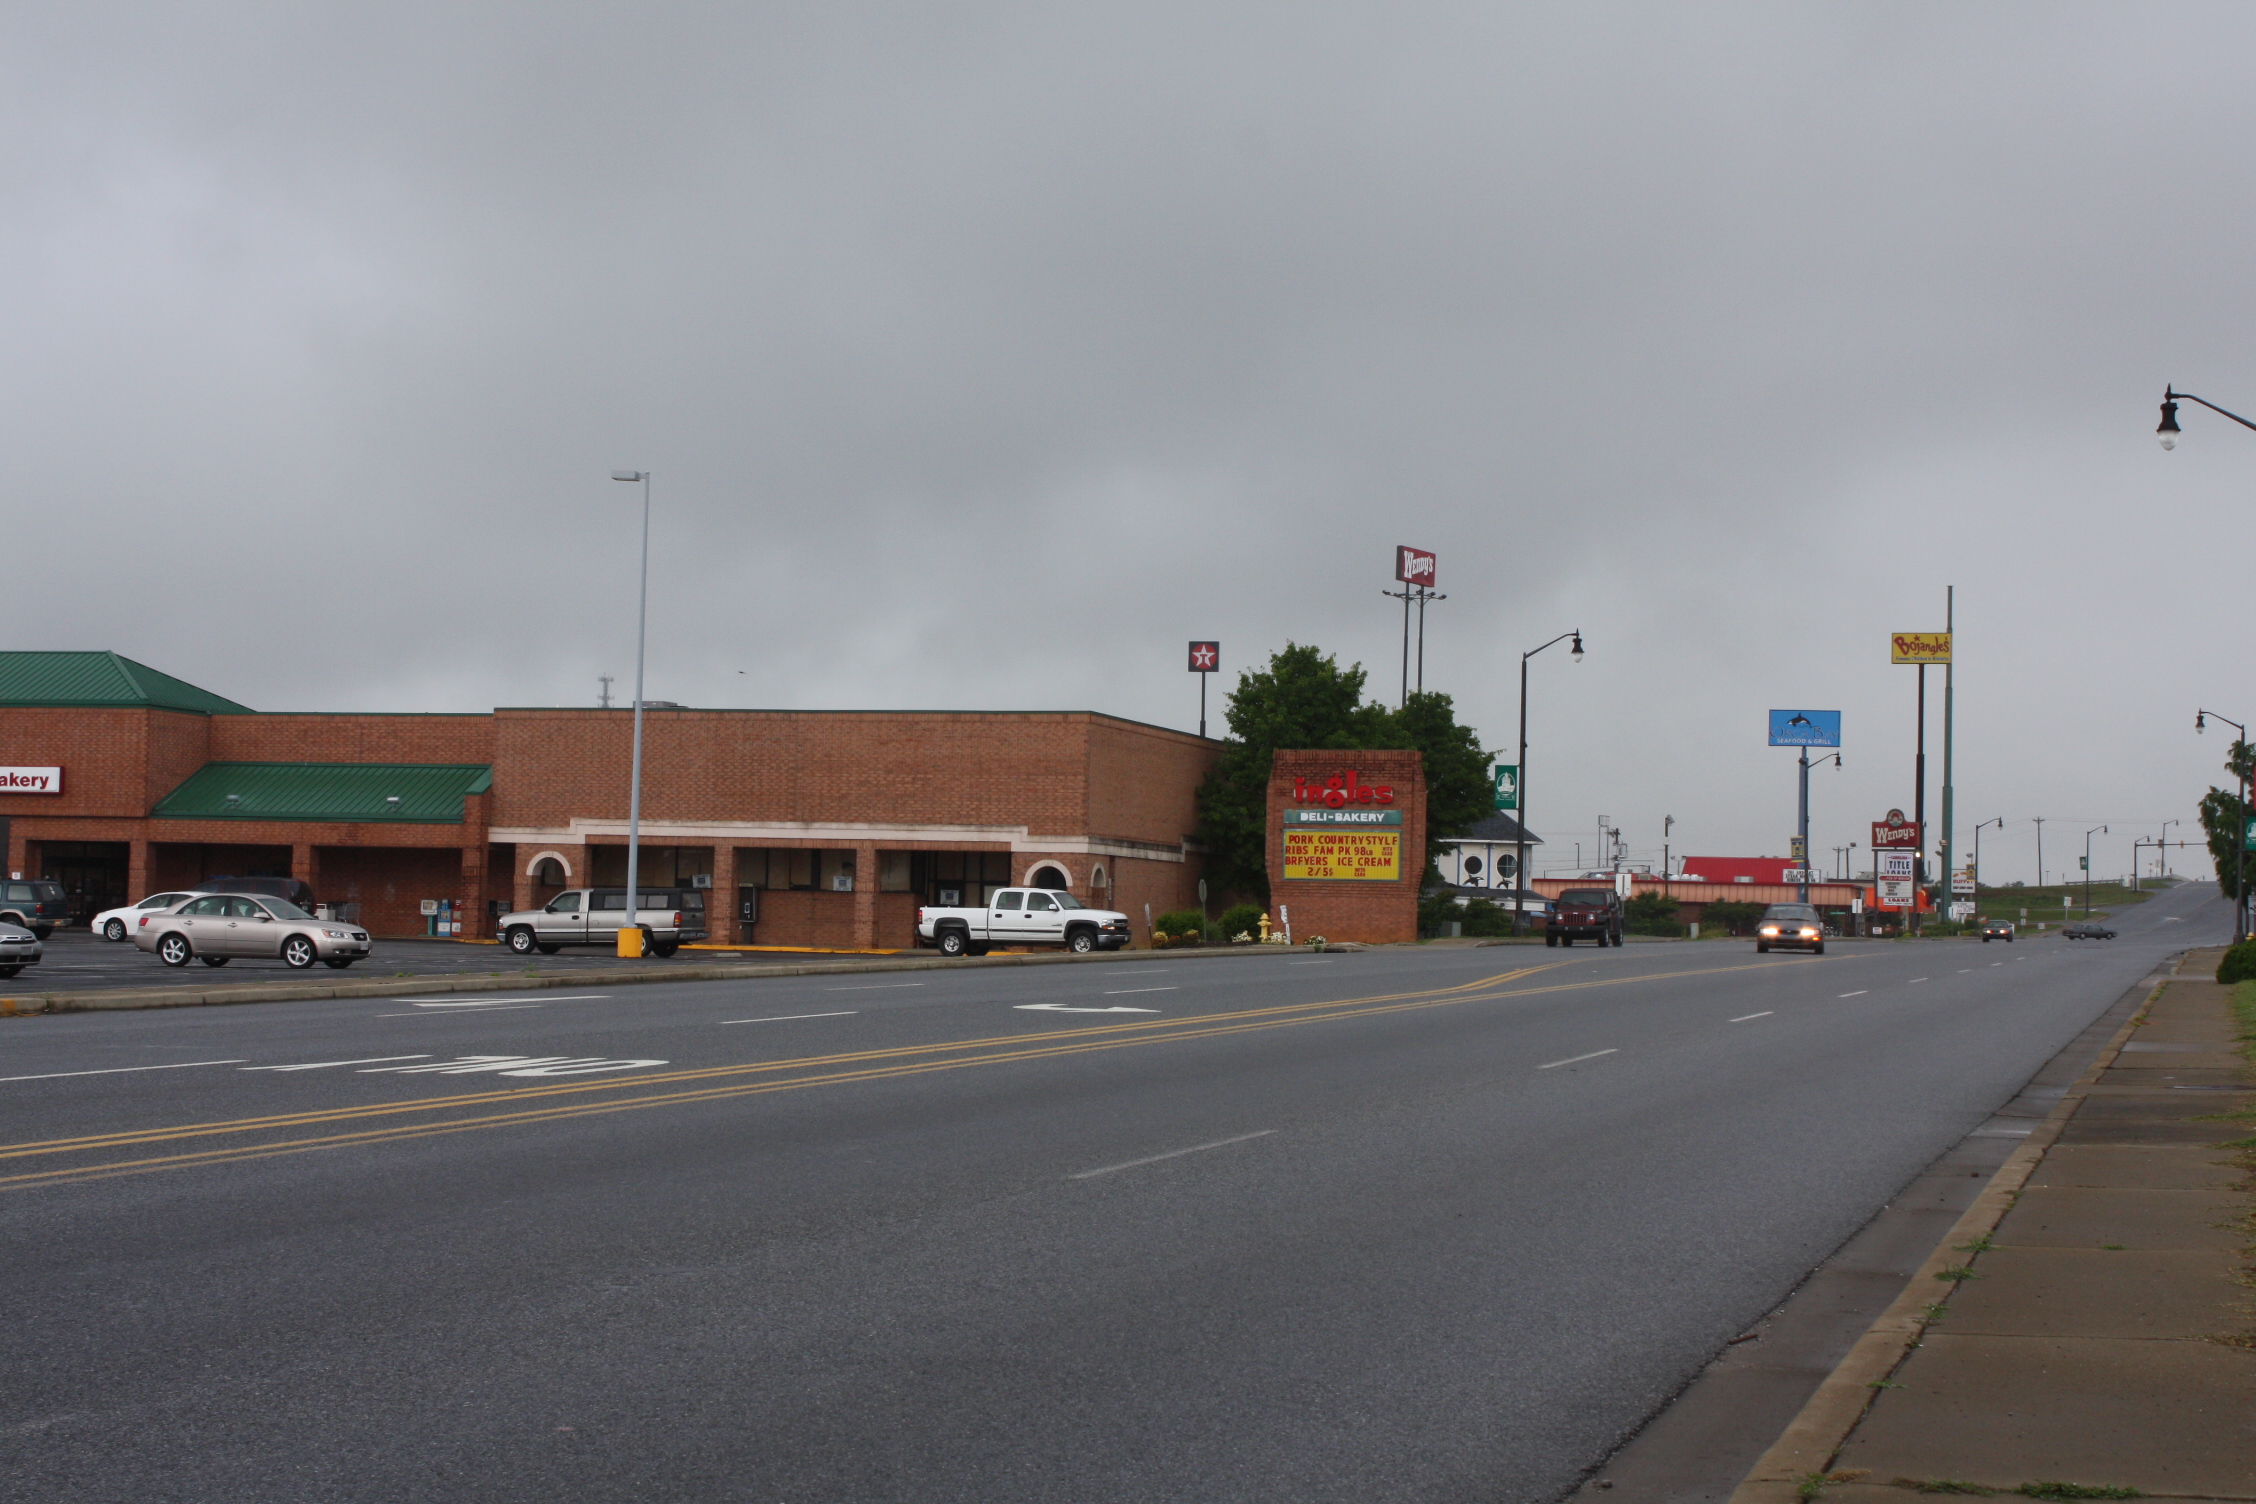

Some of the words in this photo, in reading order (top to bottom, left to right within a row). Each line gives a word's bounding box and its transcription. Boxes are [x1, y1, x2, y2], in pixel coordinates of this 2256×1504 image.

[0, 772, 49, 790] akery
[1295, 770, 1393, 808] ingles
[1300, 812, 1385, 822] DELI-BAKERY
[1288, 835, 1314, 844] PORK
[1285, 845, 1308, 855] RIBS
[1314, 846, 1334, 855] FAM
[1338, 846, 1351, 855] PK
[1337, 857, 1353, 866] ICE
[1358, 857, 1391, 866] CREAM
[1889, 861, 1910, 869] TITLE
